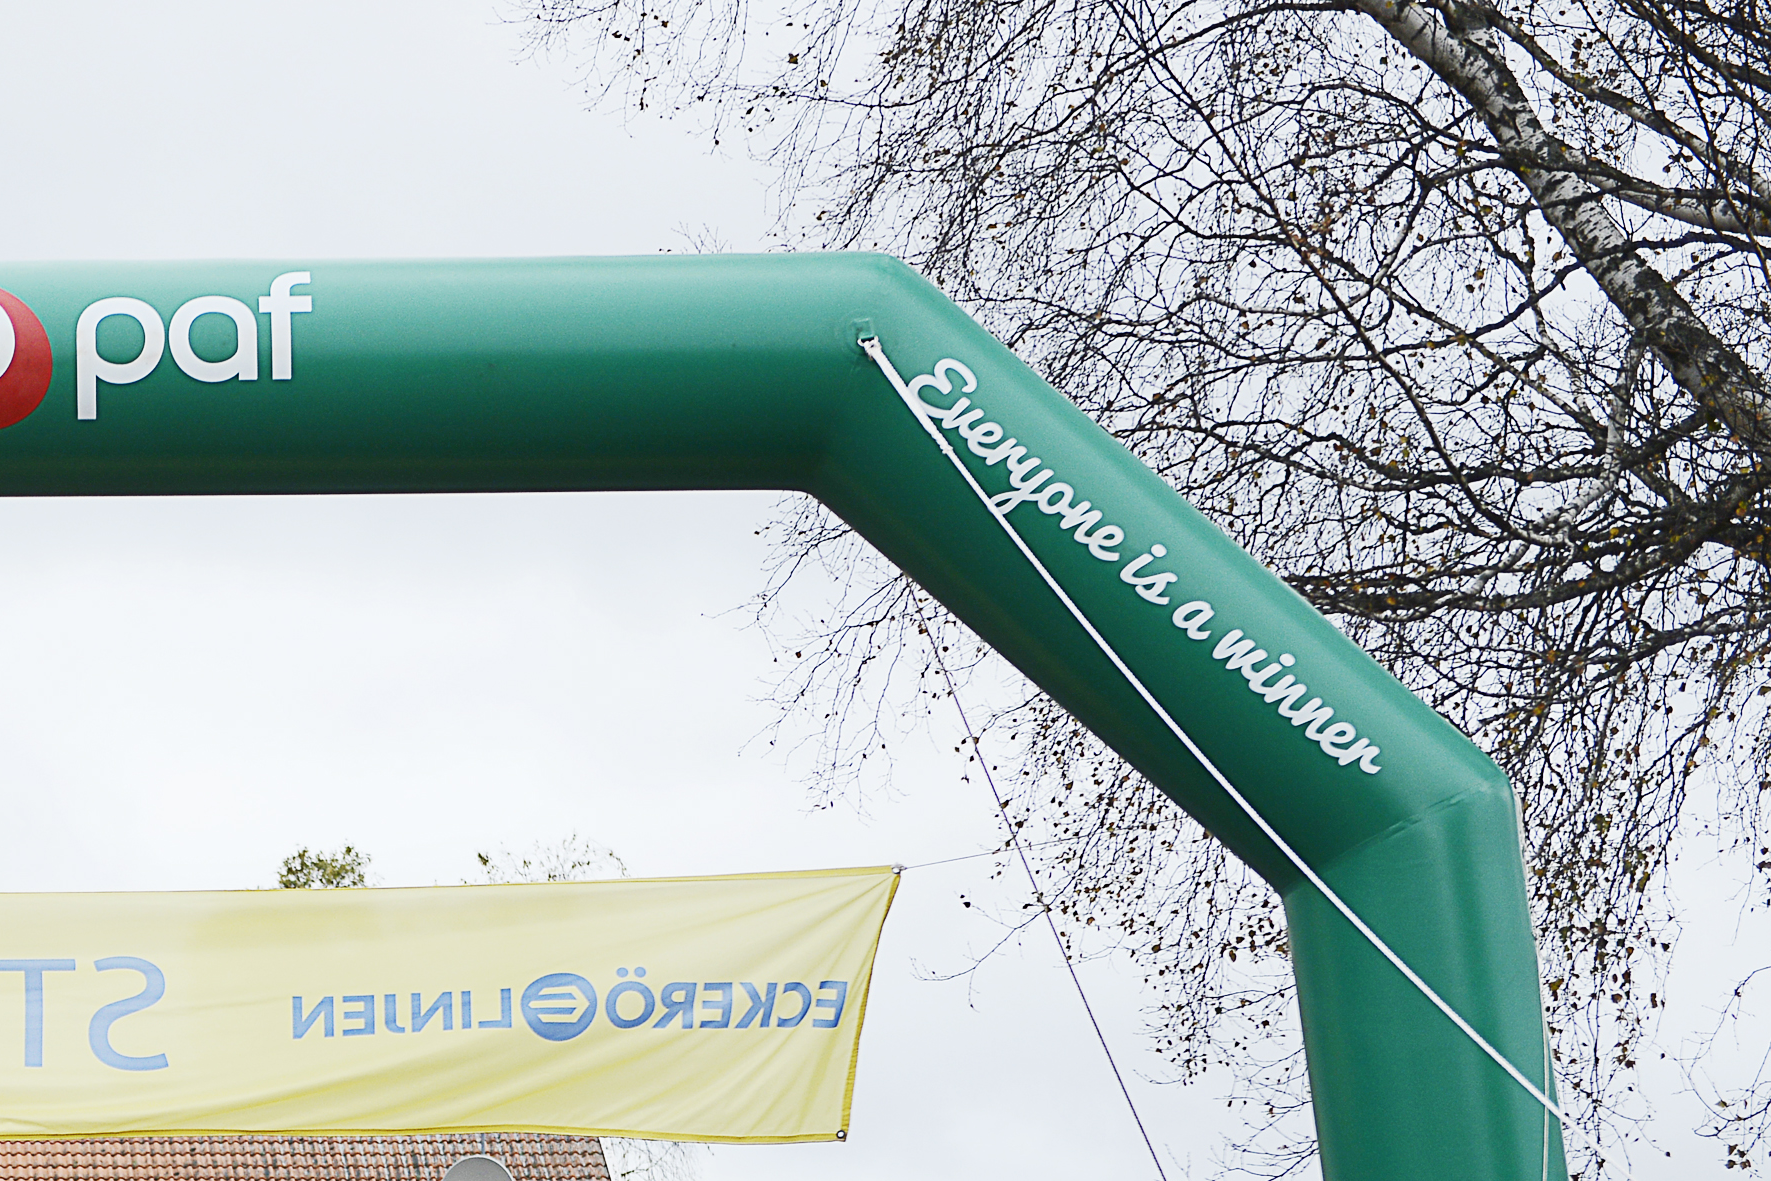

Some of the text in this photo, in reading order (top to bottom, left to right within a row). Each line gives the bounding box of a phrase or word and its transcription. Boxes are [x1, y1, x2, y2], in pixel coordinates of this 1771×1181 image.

[76, 271, 313, 420] paf
[906, 358, 1382, 775] Everyone is a winner
